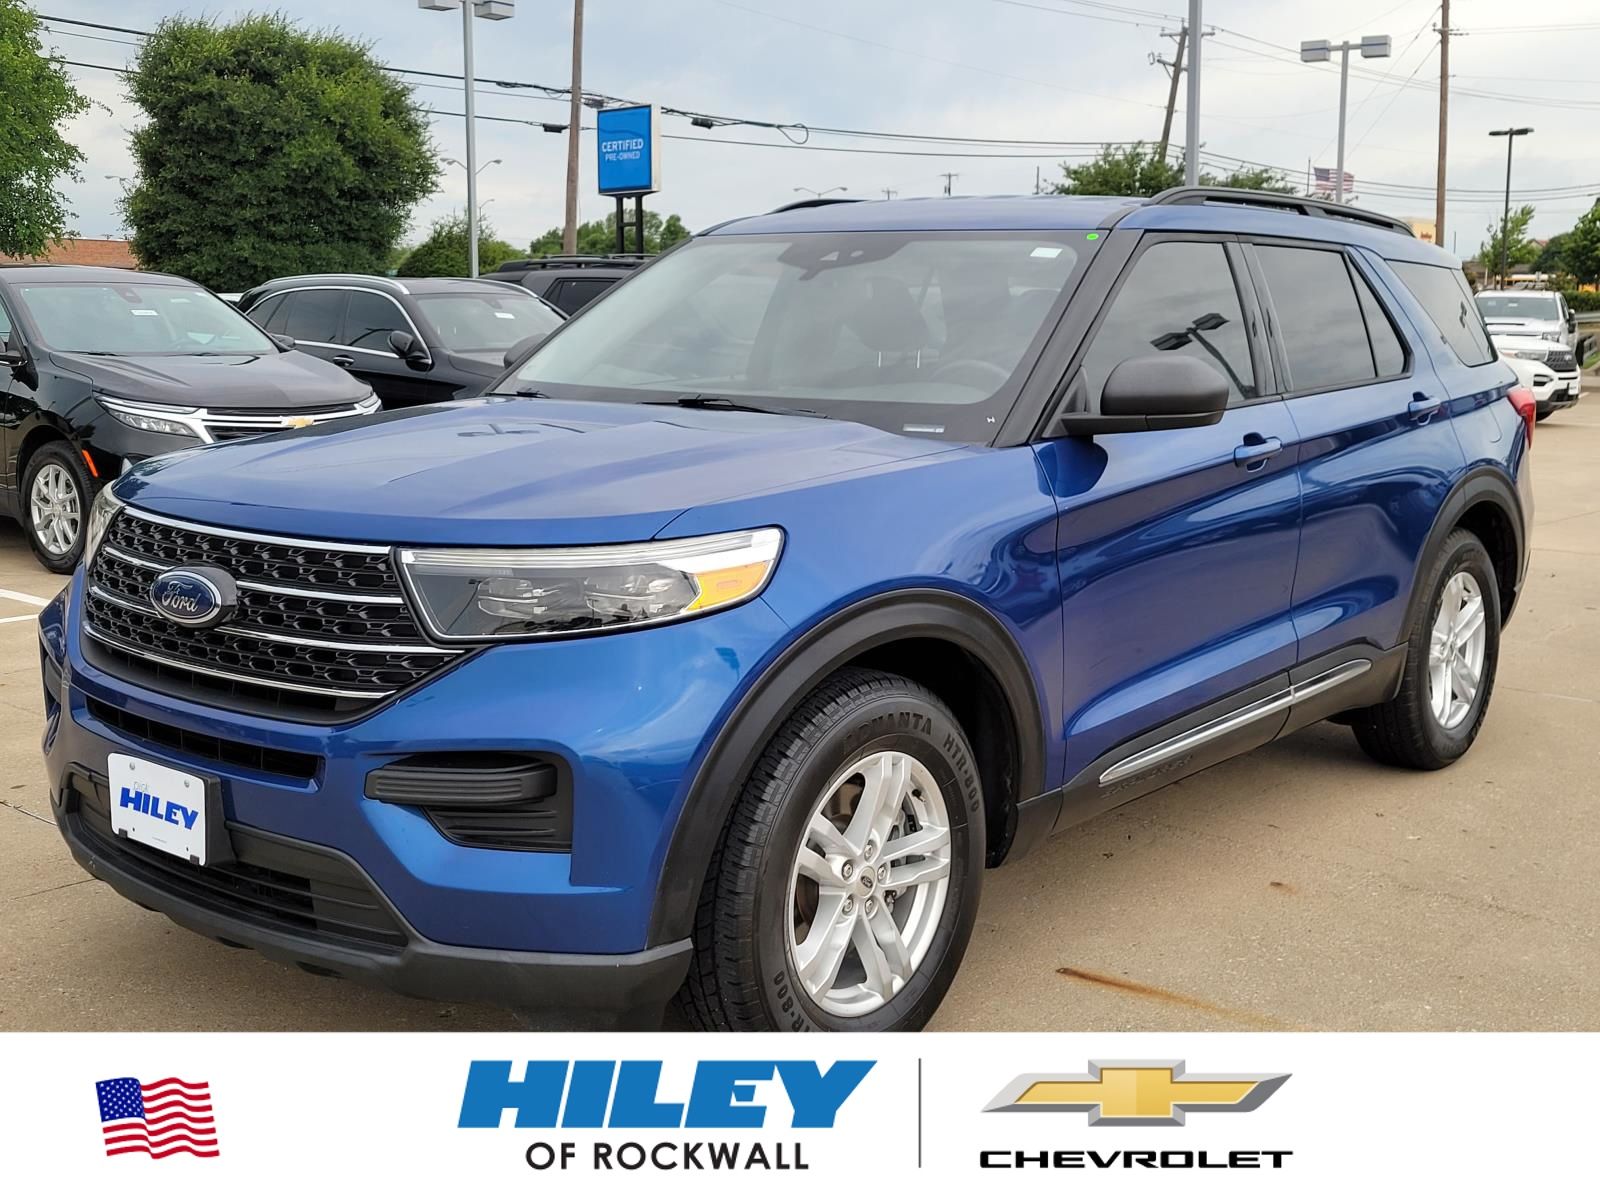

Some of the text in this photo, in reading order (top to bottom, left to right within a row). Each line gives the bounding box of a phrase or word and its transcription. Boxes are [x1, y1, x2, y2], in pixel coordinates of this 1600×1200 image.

[601, 138, 644, 153] CERTIFIED
[605, 150, 641, 161] PRE-OWNED
[161, 580, 202, 612] Ford
[119, 786, 199, 831] HILEY
